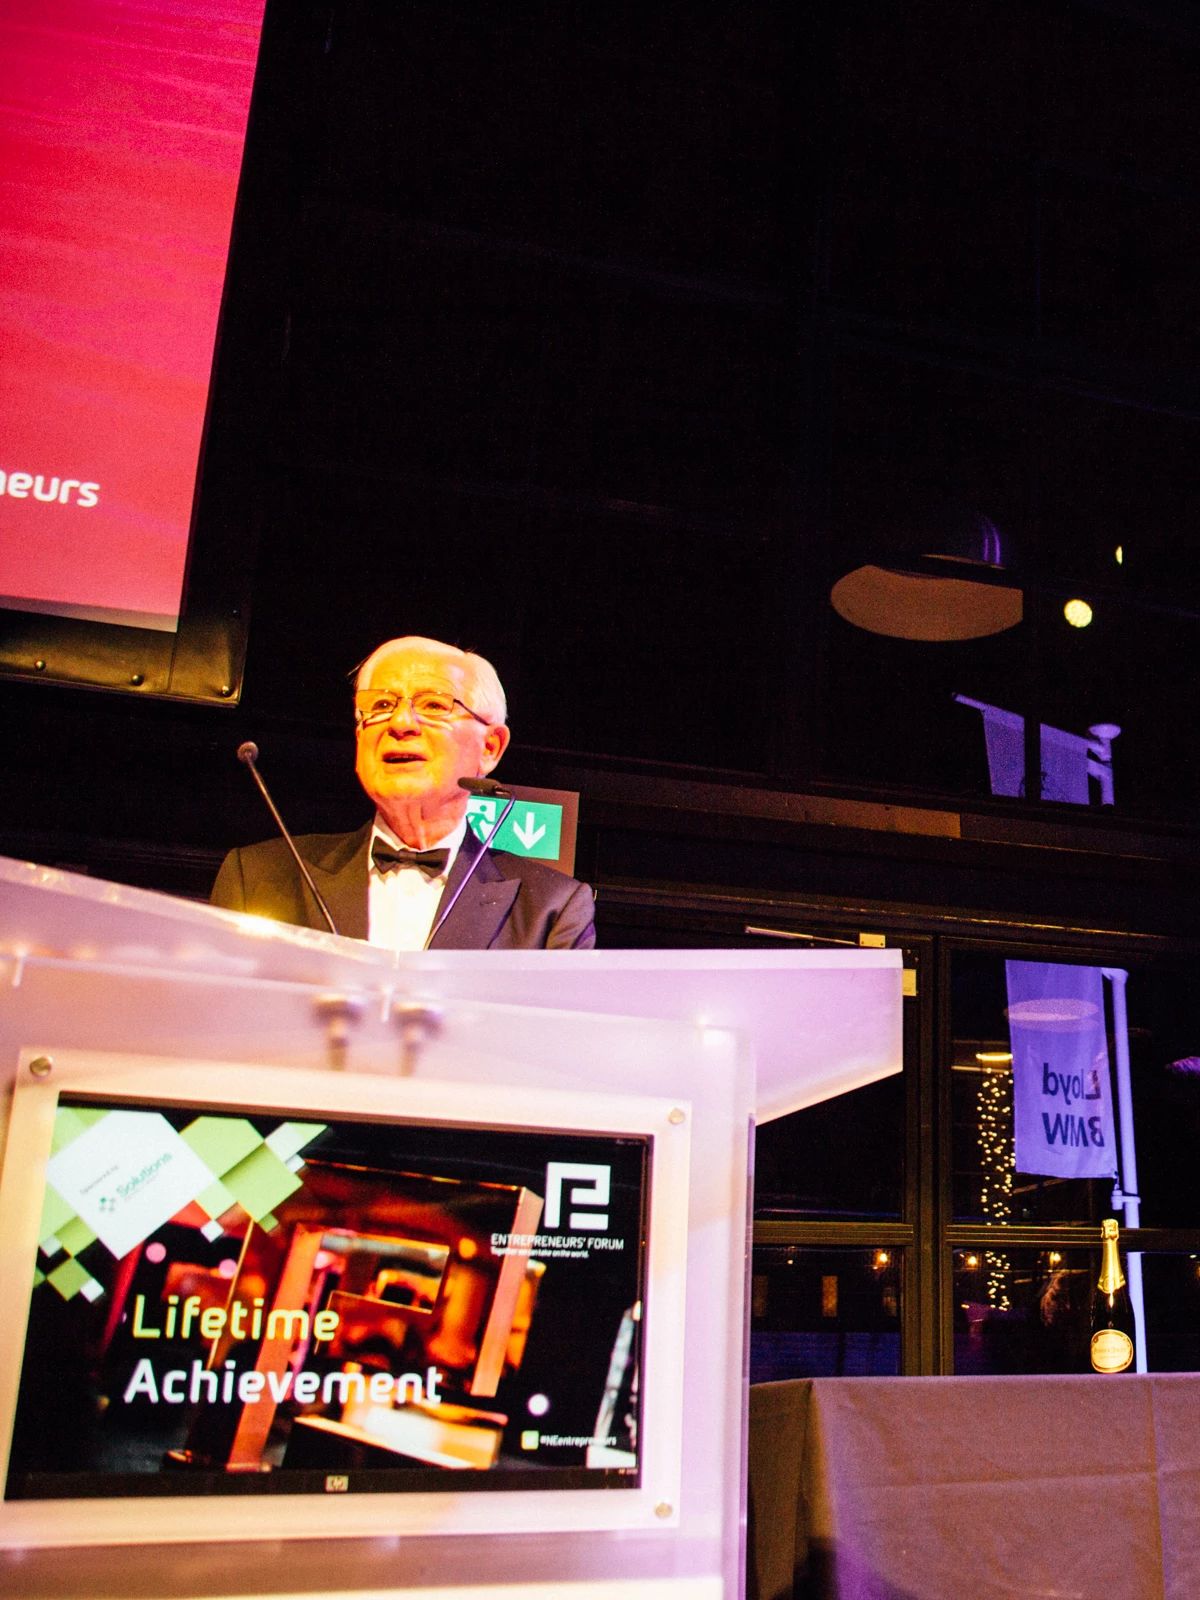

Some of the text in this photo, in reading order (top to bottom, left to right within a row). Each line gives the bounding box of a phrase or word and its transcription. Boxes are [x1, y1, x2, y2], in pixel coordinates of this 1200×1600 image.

[116, 1152, 173, 1197] Solutions
[587, 1237, 624, 1250] FORUM
[133, 1294, 340, 1340] Lifetime
[124, 1358, 443, 1403] Achievement
